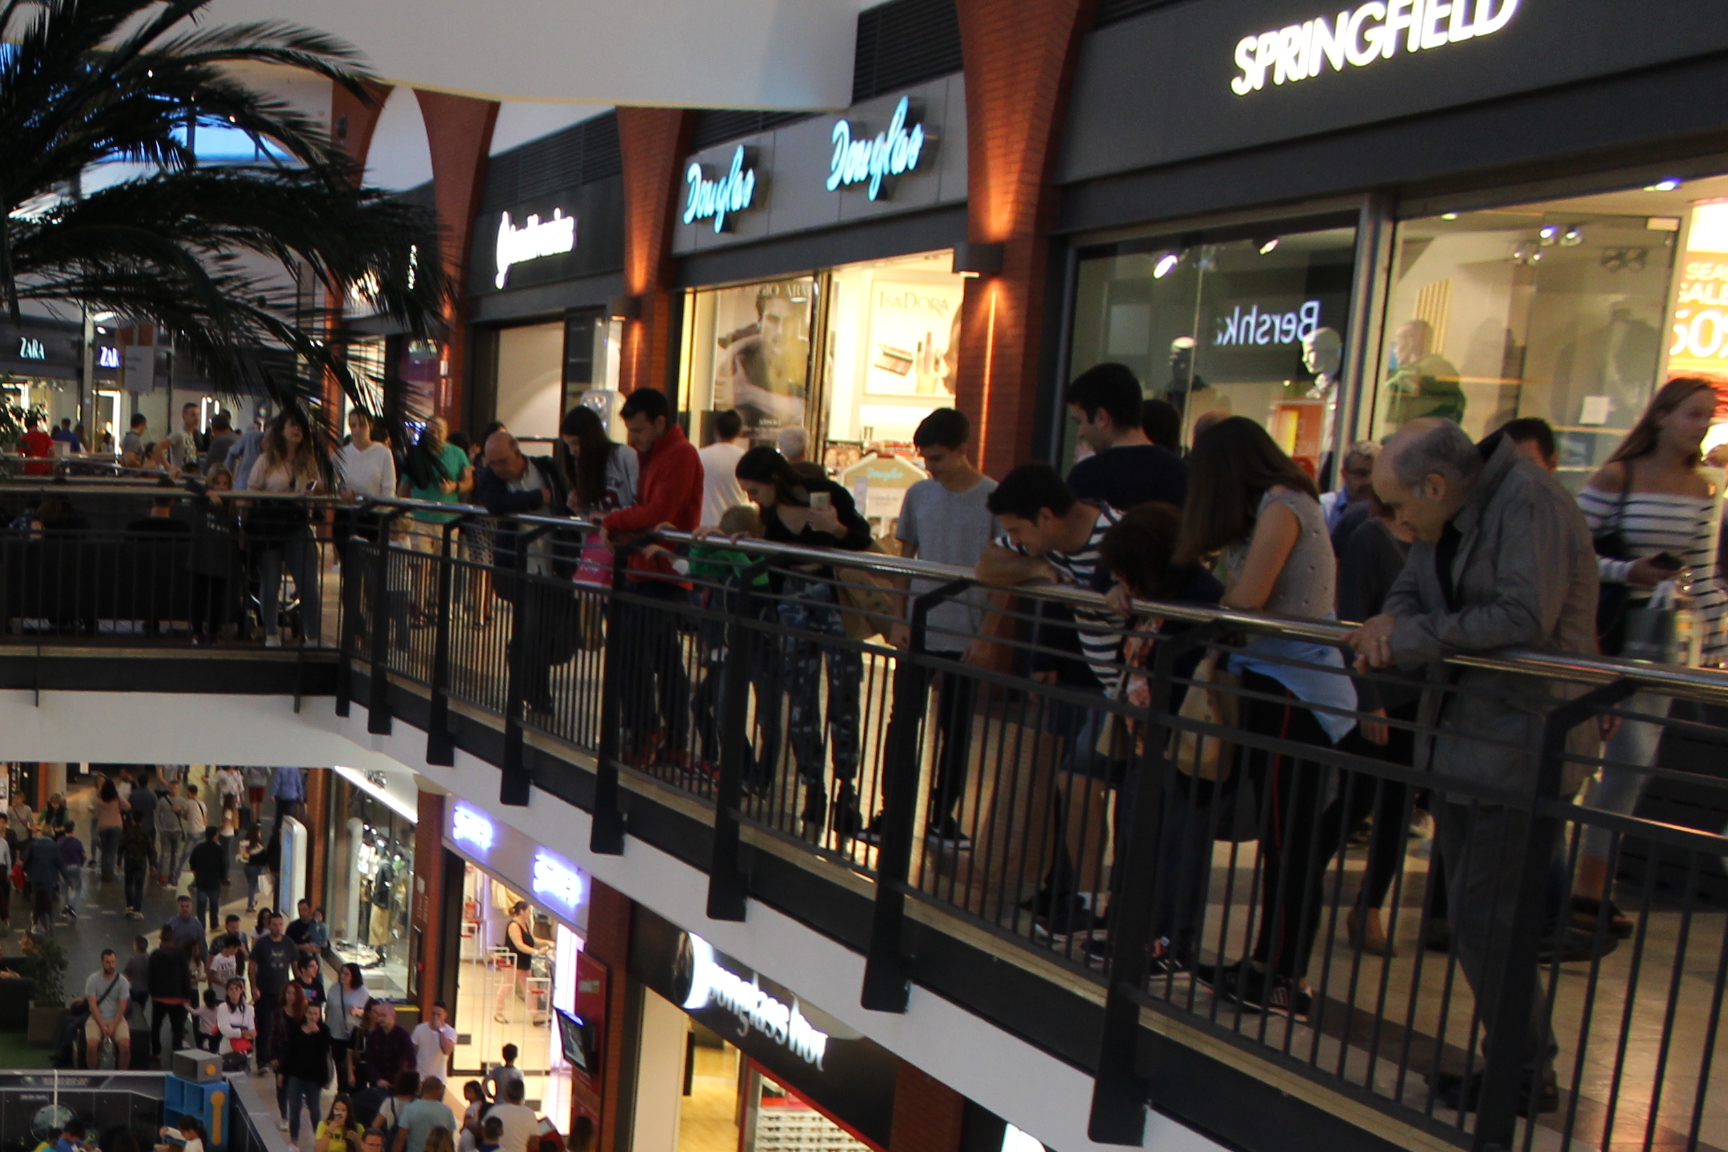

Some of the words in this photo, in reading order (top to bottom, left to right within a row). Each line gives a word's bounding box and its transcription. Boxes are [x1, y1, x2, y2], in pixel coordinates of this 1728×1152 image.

[1230, 0, 1522, 96] SPRINGFIELD
[683, 145, 756, 234] Douglas
[827, 95, 924, 201] Douglas
[19, 336, 46, 360] ZARA
